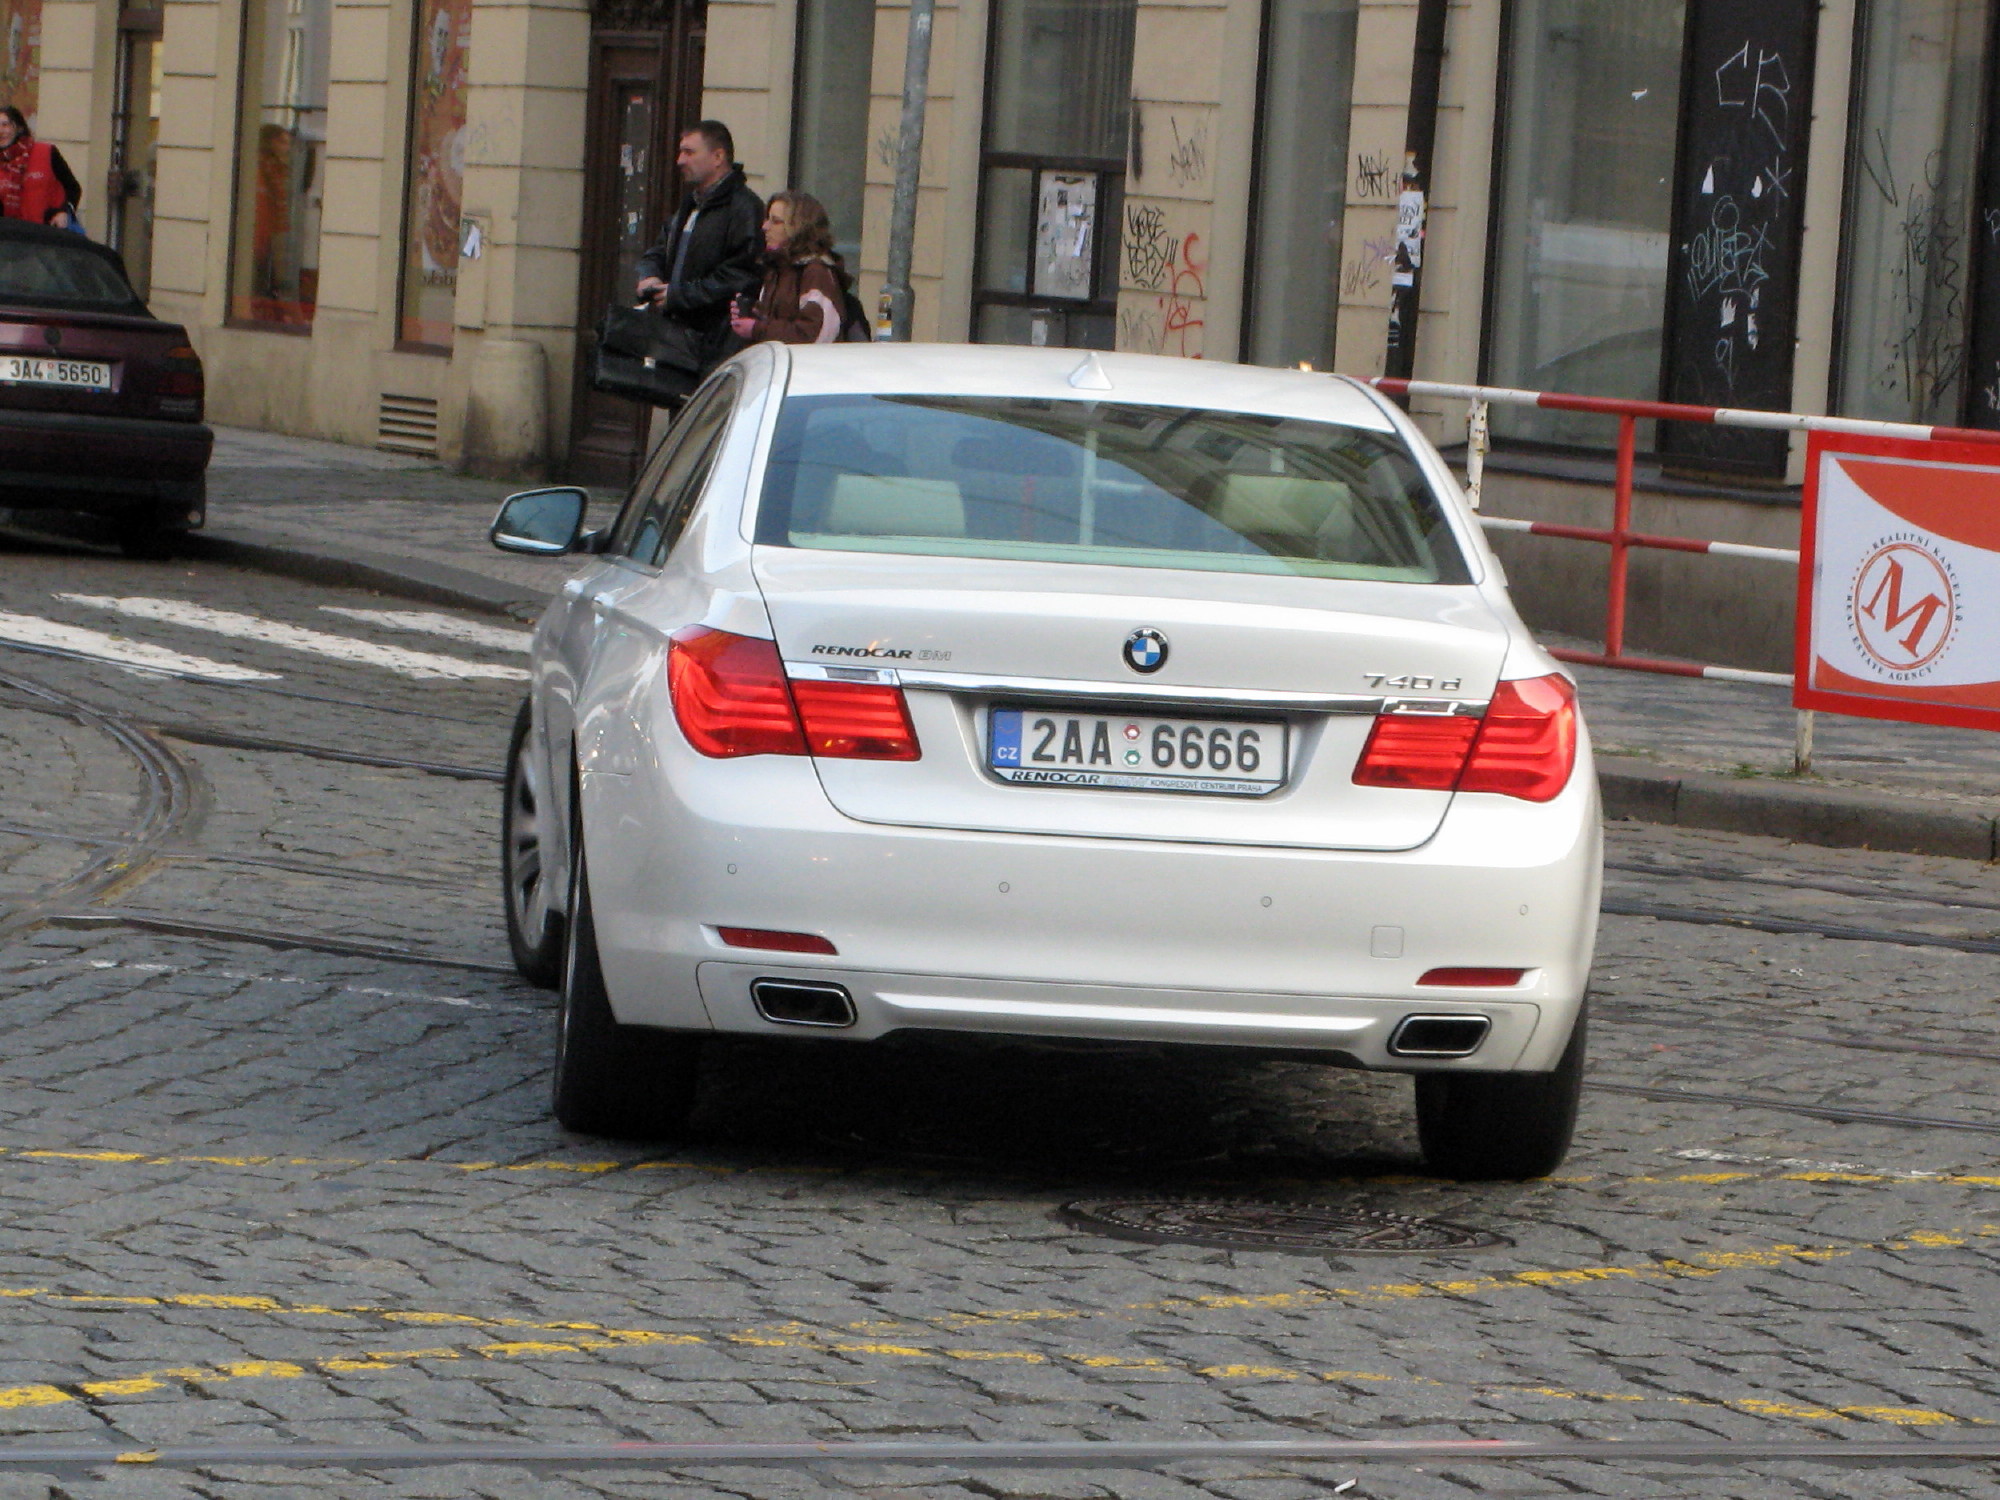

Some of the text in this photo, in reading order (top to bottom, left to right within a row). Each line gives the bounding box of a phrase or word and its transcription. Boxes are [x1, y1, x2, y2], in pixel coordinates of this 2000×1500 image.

[10, 360, 101, 384] 3A4 5650
[1872, 533, 1930, 550] REALITNÍ
[1861, 555, 1947, 658] M
[811, 644, 913, 659] RENOCAR
[1852, 636, 1883, 674] ESTATE
[1888, 665, 1933, 681] AGENCY
[997, 747, 1018, 760] CZ
[1032, 718, 1260, 772] 2AA 6666
[1011, 771, 1100, 784] RENOCAR
[1200, 782, 1236, 791] CENTRUM
[1237, 784, 1263, 792] PRAHA
